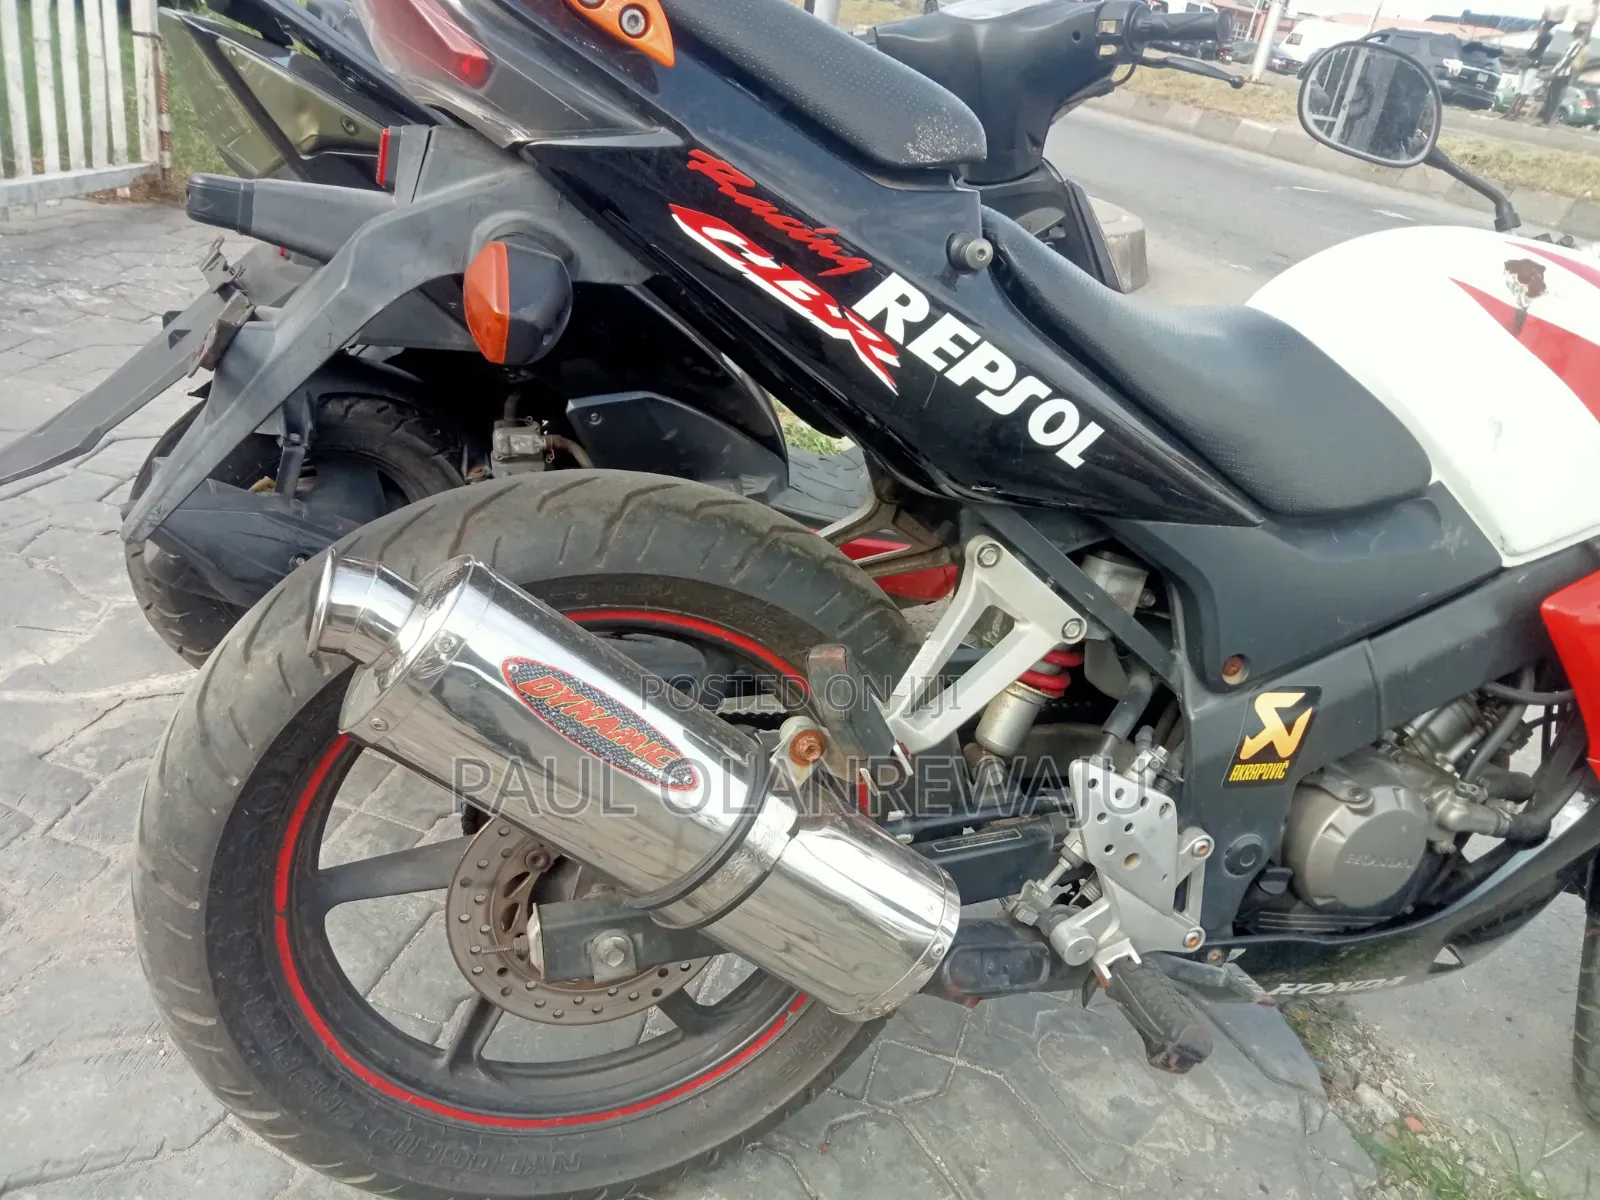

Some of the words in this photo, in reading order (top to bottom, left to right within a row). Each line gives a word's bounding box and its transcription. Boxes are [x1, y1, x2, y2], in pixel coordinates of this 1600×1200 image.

[687, 149, 872, 276] Racing
[669, 203, 900, 396] CBR
[852, 272, 1105, 469] REPSOL
[516, 675, 684, 768] DYNAMIC
